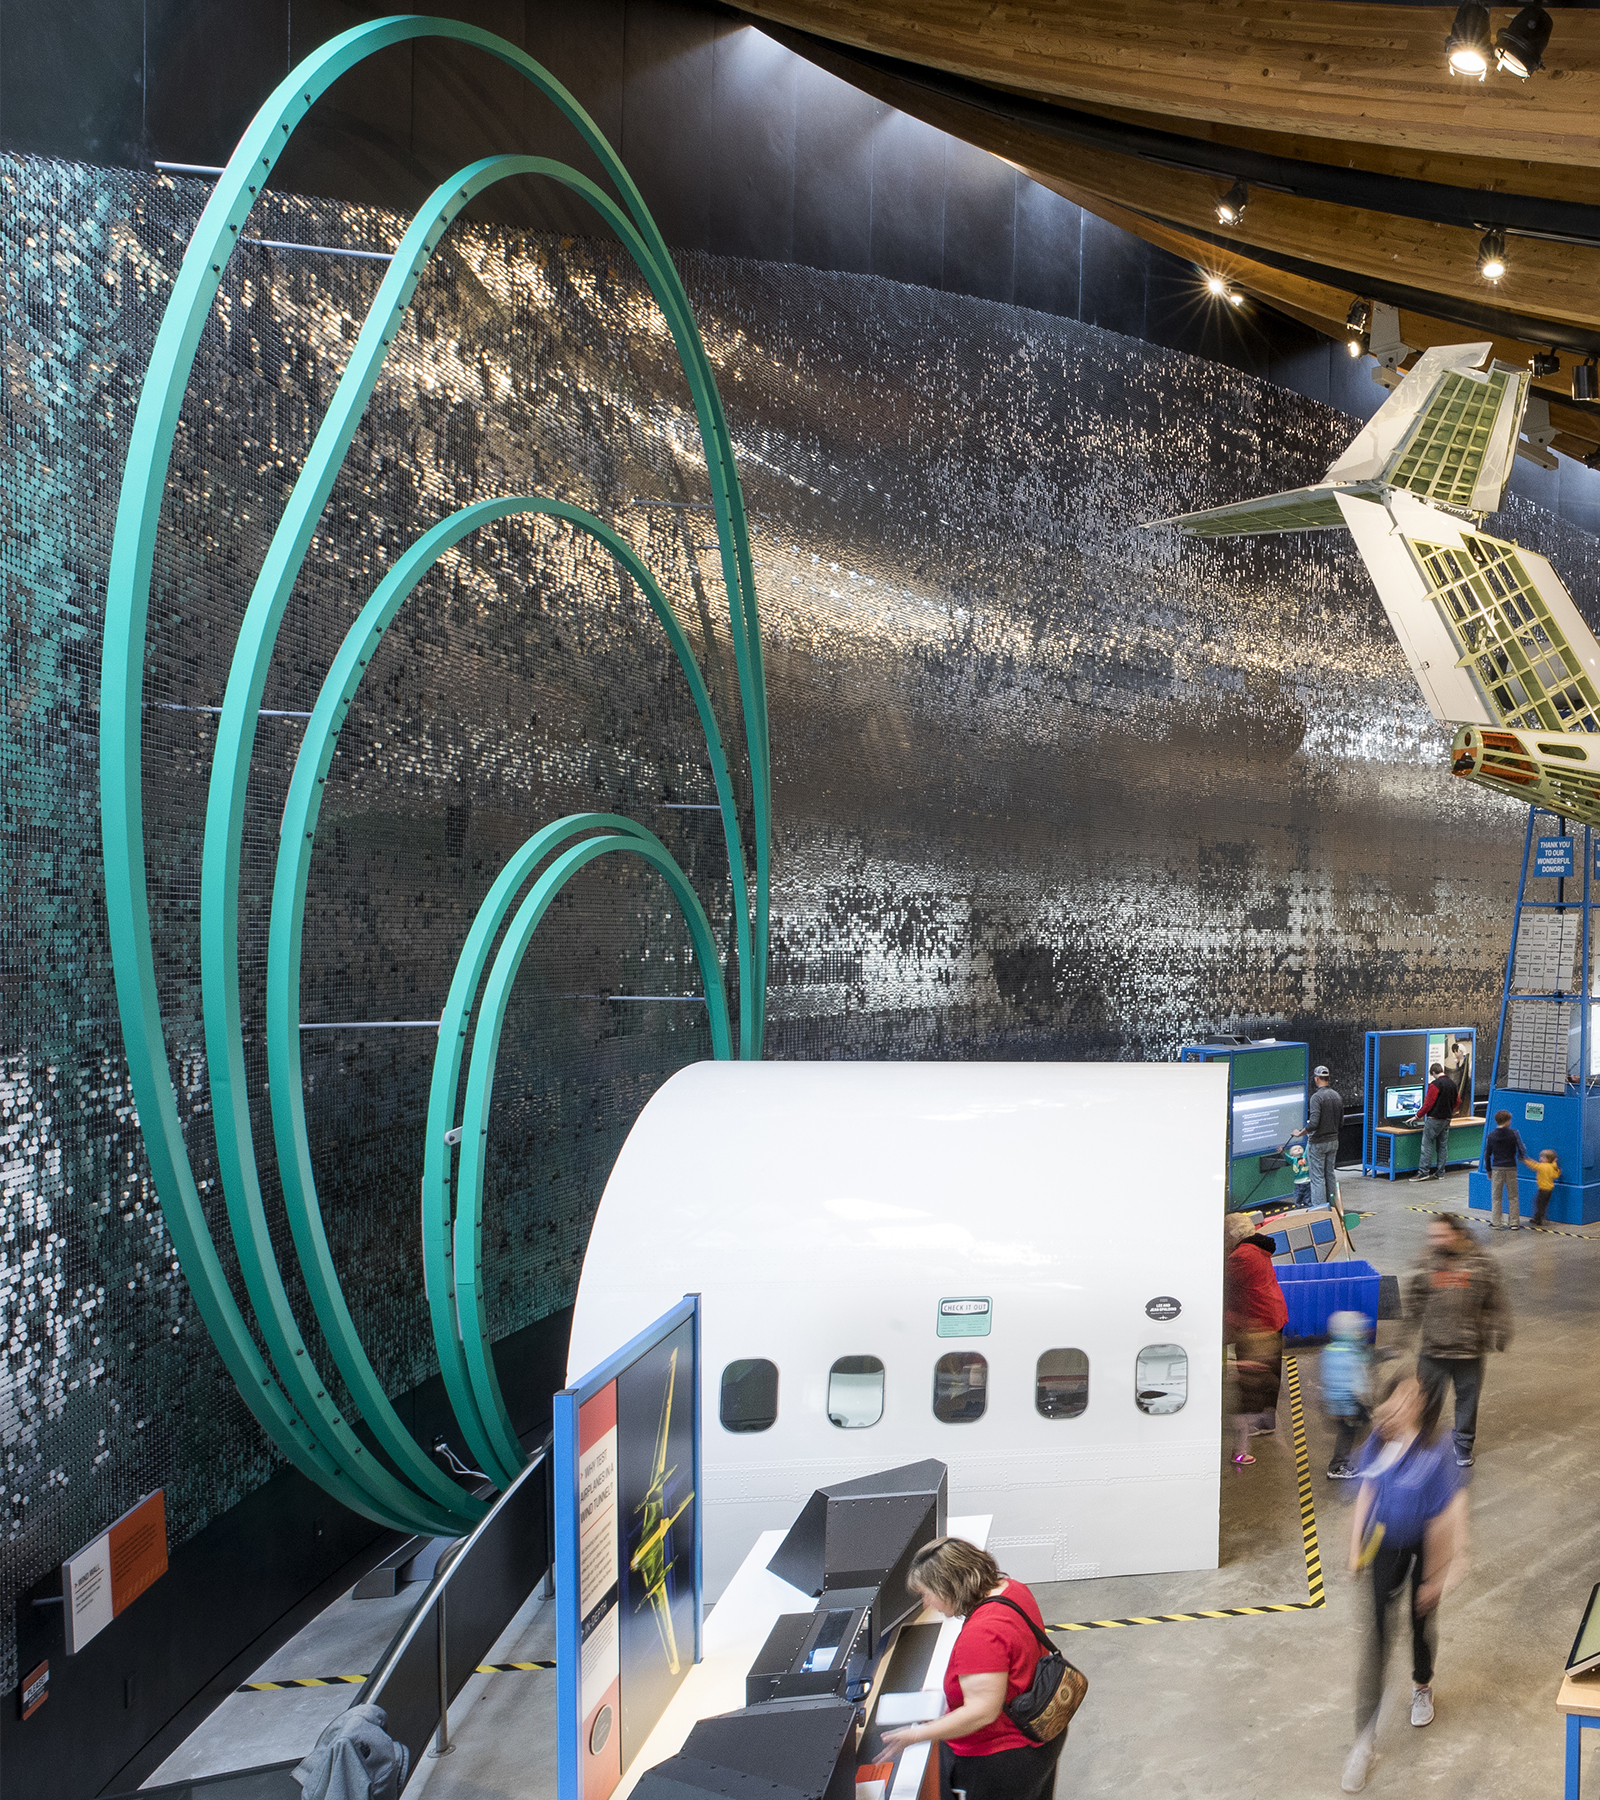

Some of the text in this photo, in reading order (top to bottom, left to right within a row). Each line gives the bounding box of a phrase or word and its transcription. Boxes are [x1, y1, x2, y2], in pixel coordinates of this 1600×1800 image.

[1540, 841, 1558, 849] THANK
[1545, 849, 1565, 857] TO OUR
[1537, 857, 1571, 865] WONDERFUL
[1541, 865, 1565, 873] DONORS
[584, 1448, 608, 1479] WHY TEST
[580, 1470, 606, 1502] AIRPLANES
[580, 1502, 594, 1524] WIND
[593, 1481, 614, 1510] TUNNEL?
